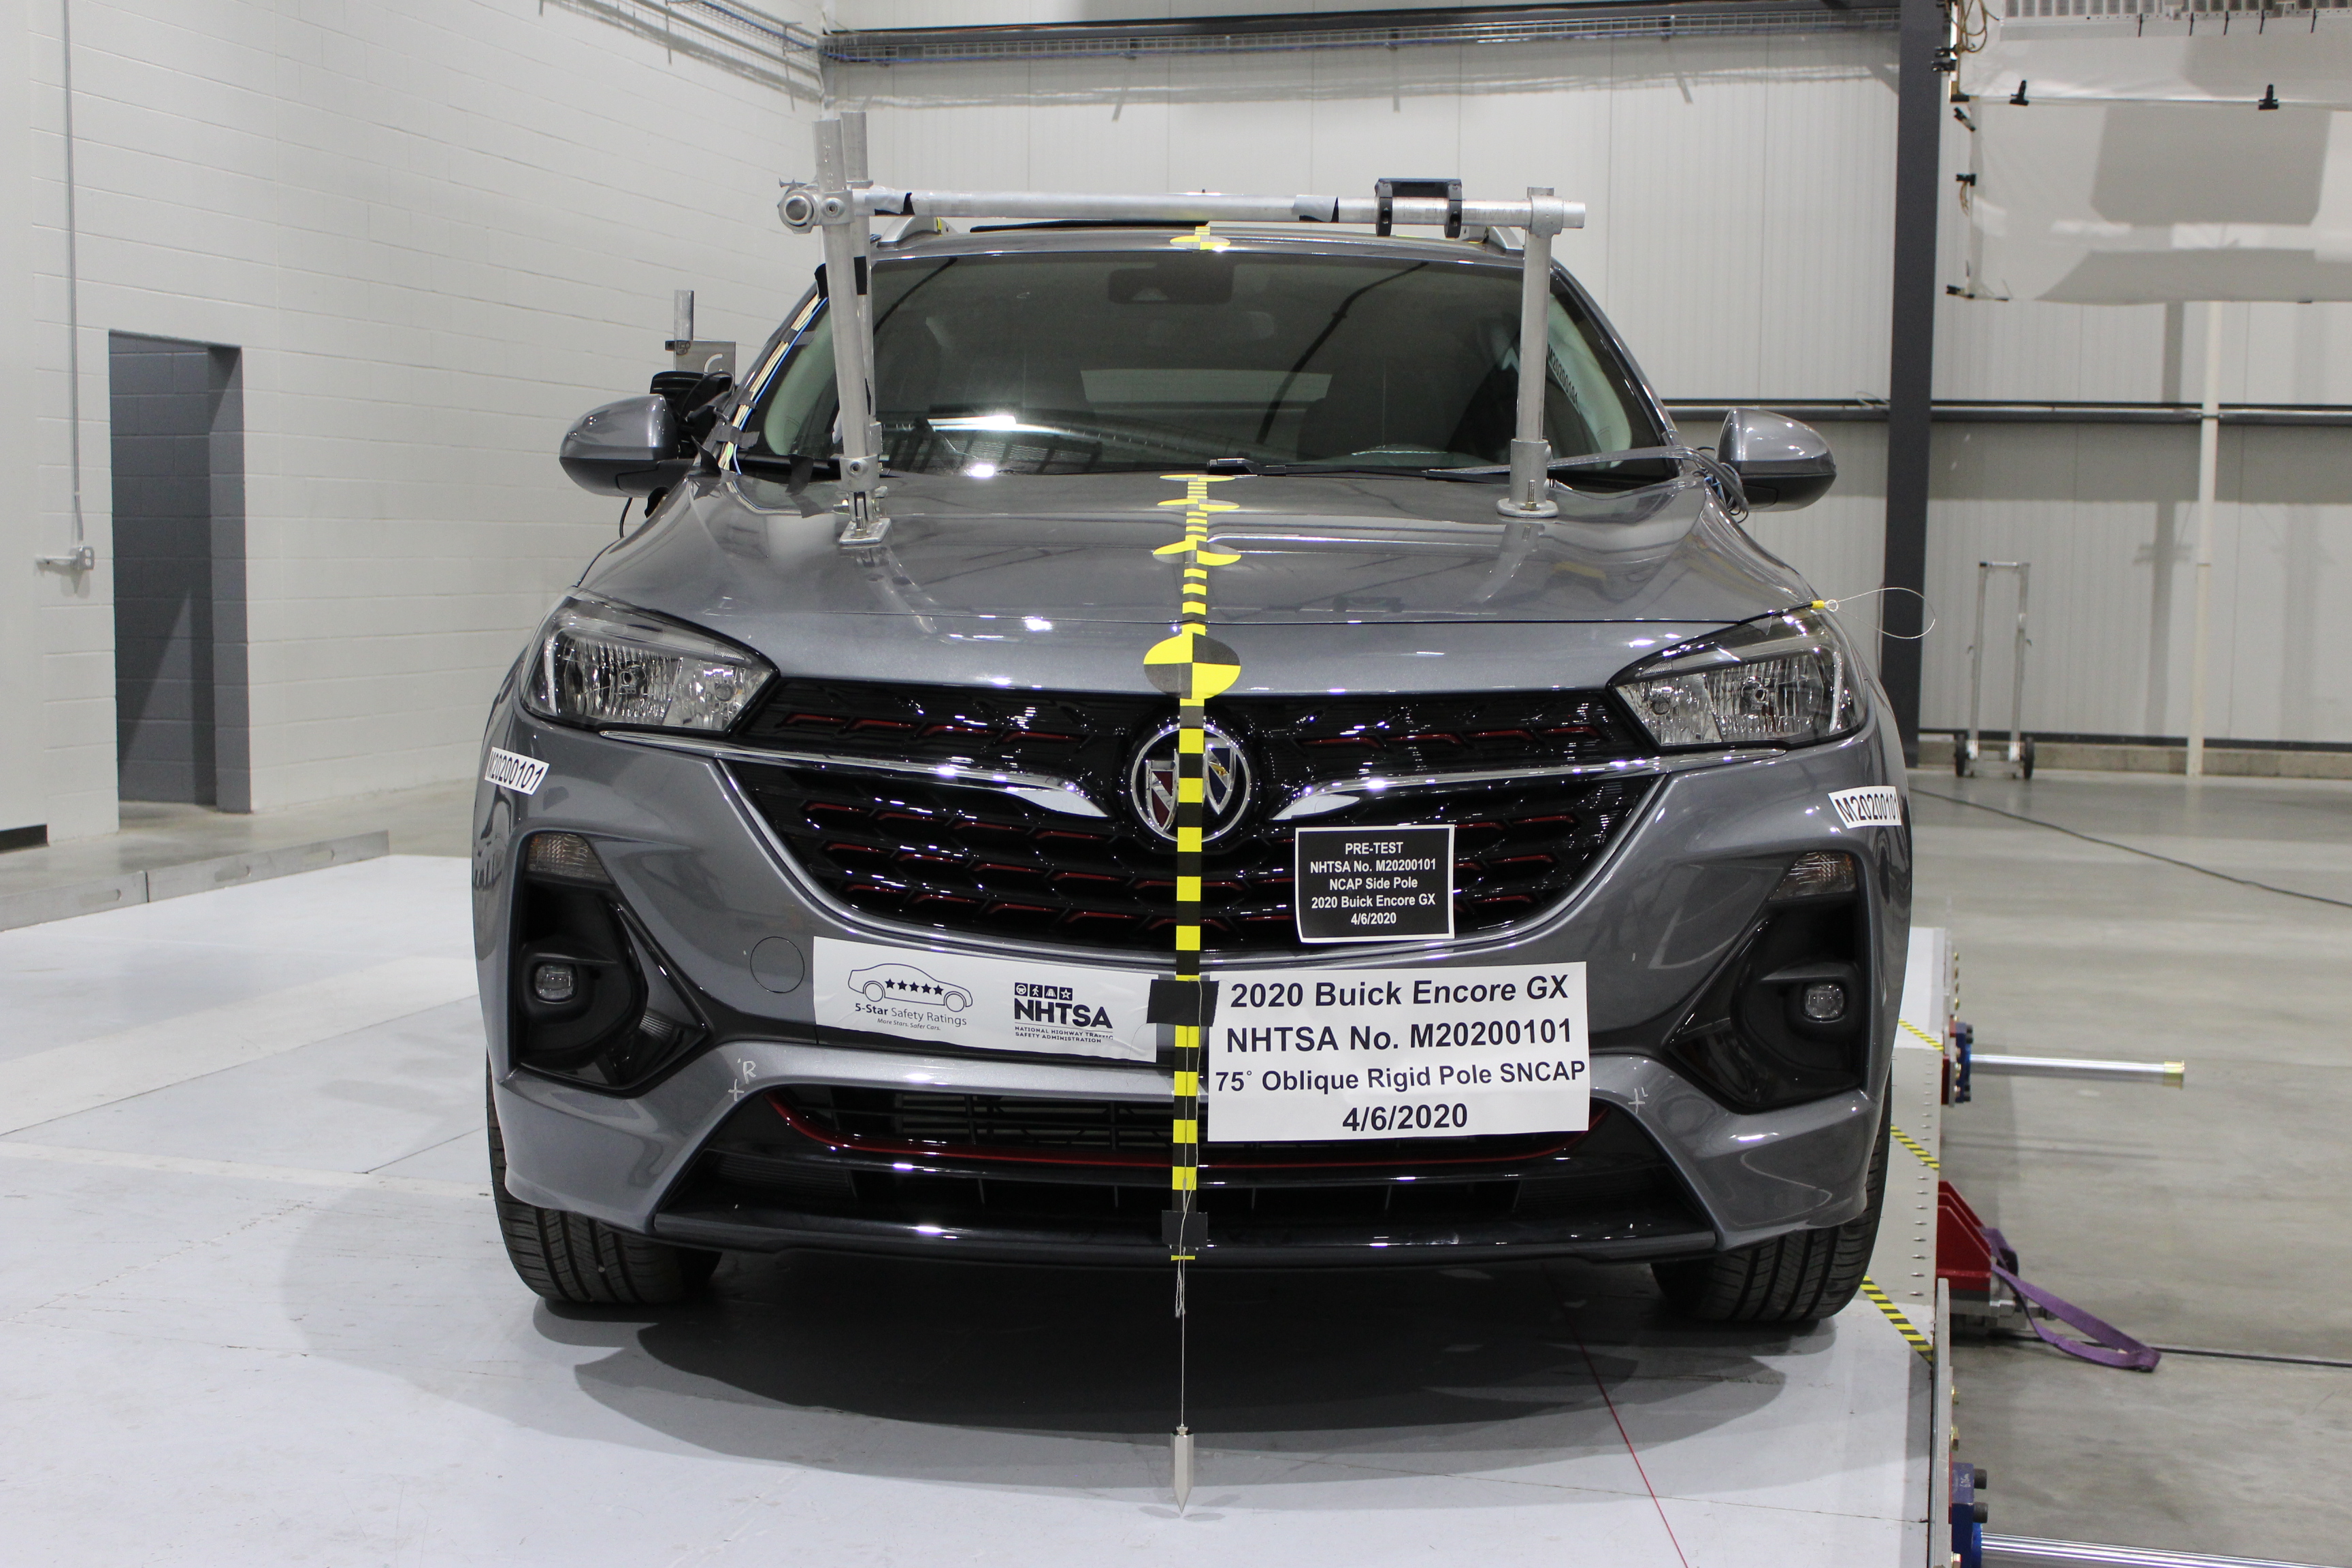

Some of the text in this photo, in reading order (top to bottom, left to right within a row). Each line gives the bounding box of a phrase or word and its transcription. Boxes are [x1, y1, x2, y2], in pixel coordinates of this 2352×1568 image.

[487, 751, 544, 791] M20200101
[1835, 793, 1899, 823] M20200101
[1345, 842, 1403, 854] PRE-TEST
[1311, 858, 1436, 874] NHTSA No. M20200101
[1329, 877, 1418, 891] NCAP Side Pole
[1311, 893, 1436, 909] 2020 Buick Encore GX
[1350, 912, 1397, 926] 4/6/2020
[1231, 974, 1568, 1008] 2020 Buick Encore GX
[855, 1003, 967, 1027] 5-Star Safety Ratings
[1015, 998, 1113, 1028] NHTSA
[1042, 1034, 1101, 1043] ADMINISTRATION
[1227, 1018, 1570, 1053] NHTSA No. M20200101
[742, 1060, 757, 1085] R
[1215, 1061, 1584, 1094] 75° Oblique Rigid Pole SNCAP
[1343, 1103, 1467, 1131] 4/6/2020
